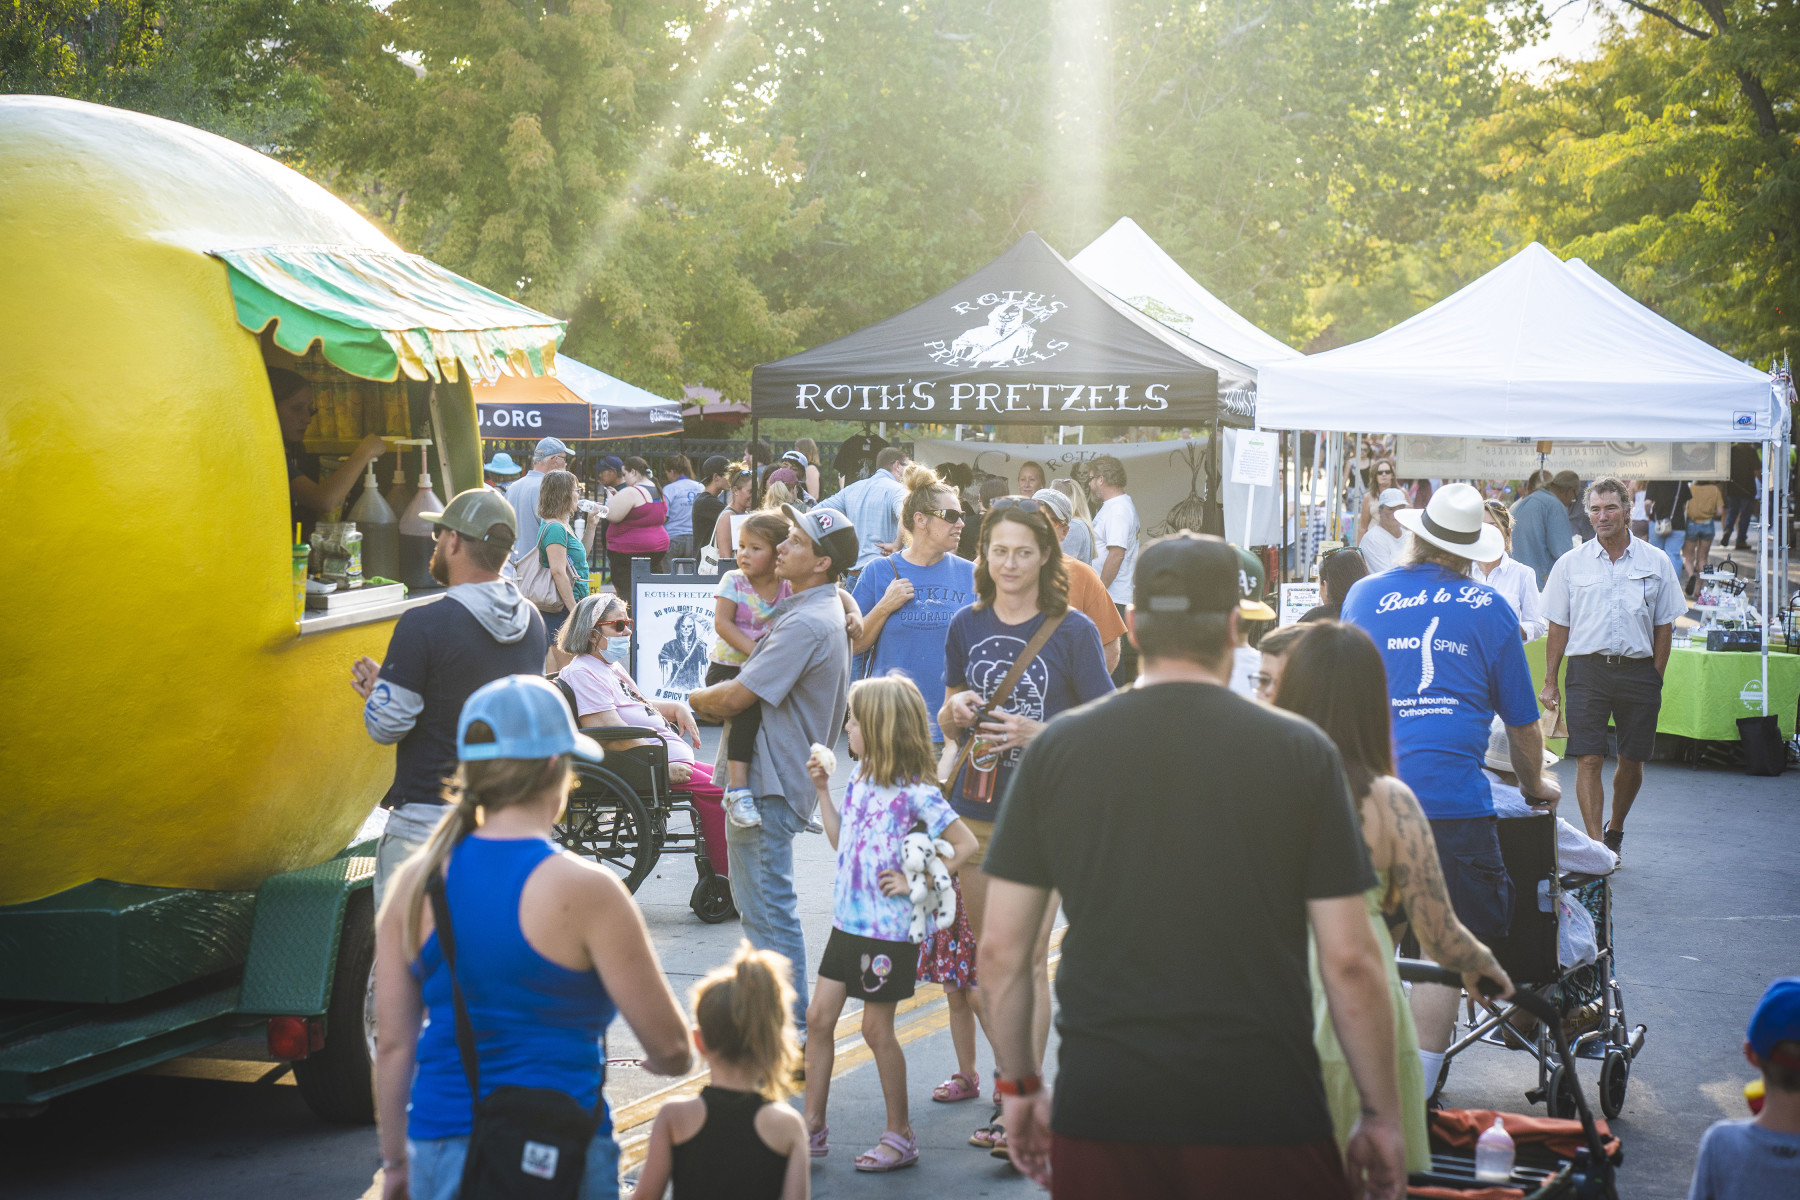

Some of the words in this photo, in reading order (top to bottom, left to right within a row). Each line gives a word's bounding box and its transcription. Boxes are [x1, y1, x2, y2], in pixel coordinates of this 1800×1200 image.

[951, 289, 1069, 316] ROTH'S
[923, 337, 1070, 369] PRETZELS
[795, 377, 937, 413] ROTH'S
[949, 382, 1171, 413] PRETZELS
[678, 591, 713, 599] PRETZE
[914, 587, 966, 604] TKIN
[1376, 589, 1429, 614] Back
[1432, 587, 1452, 603] to
[1455, 586, 1493, 609] Life
[663, 606, 676, 614] YOU
[1387, 637, 1421, 650] RMO
[1433, 638, 1469, 657] SPINE
[662, 690, 682, 701] SPICY
[1392, 697, 1418, 707] Rocky
[1419, 696, 1459, 706] Mountain
[1399, 708, 1453, 718] Orthopaedic
